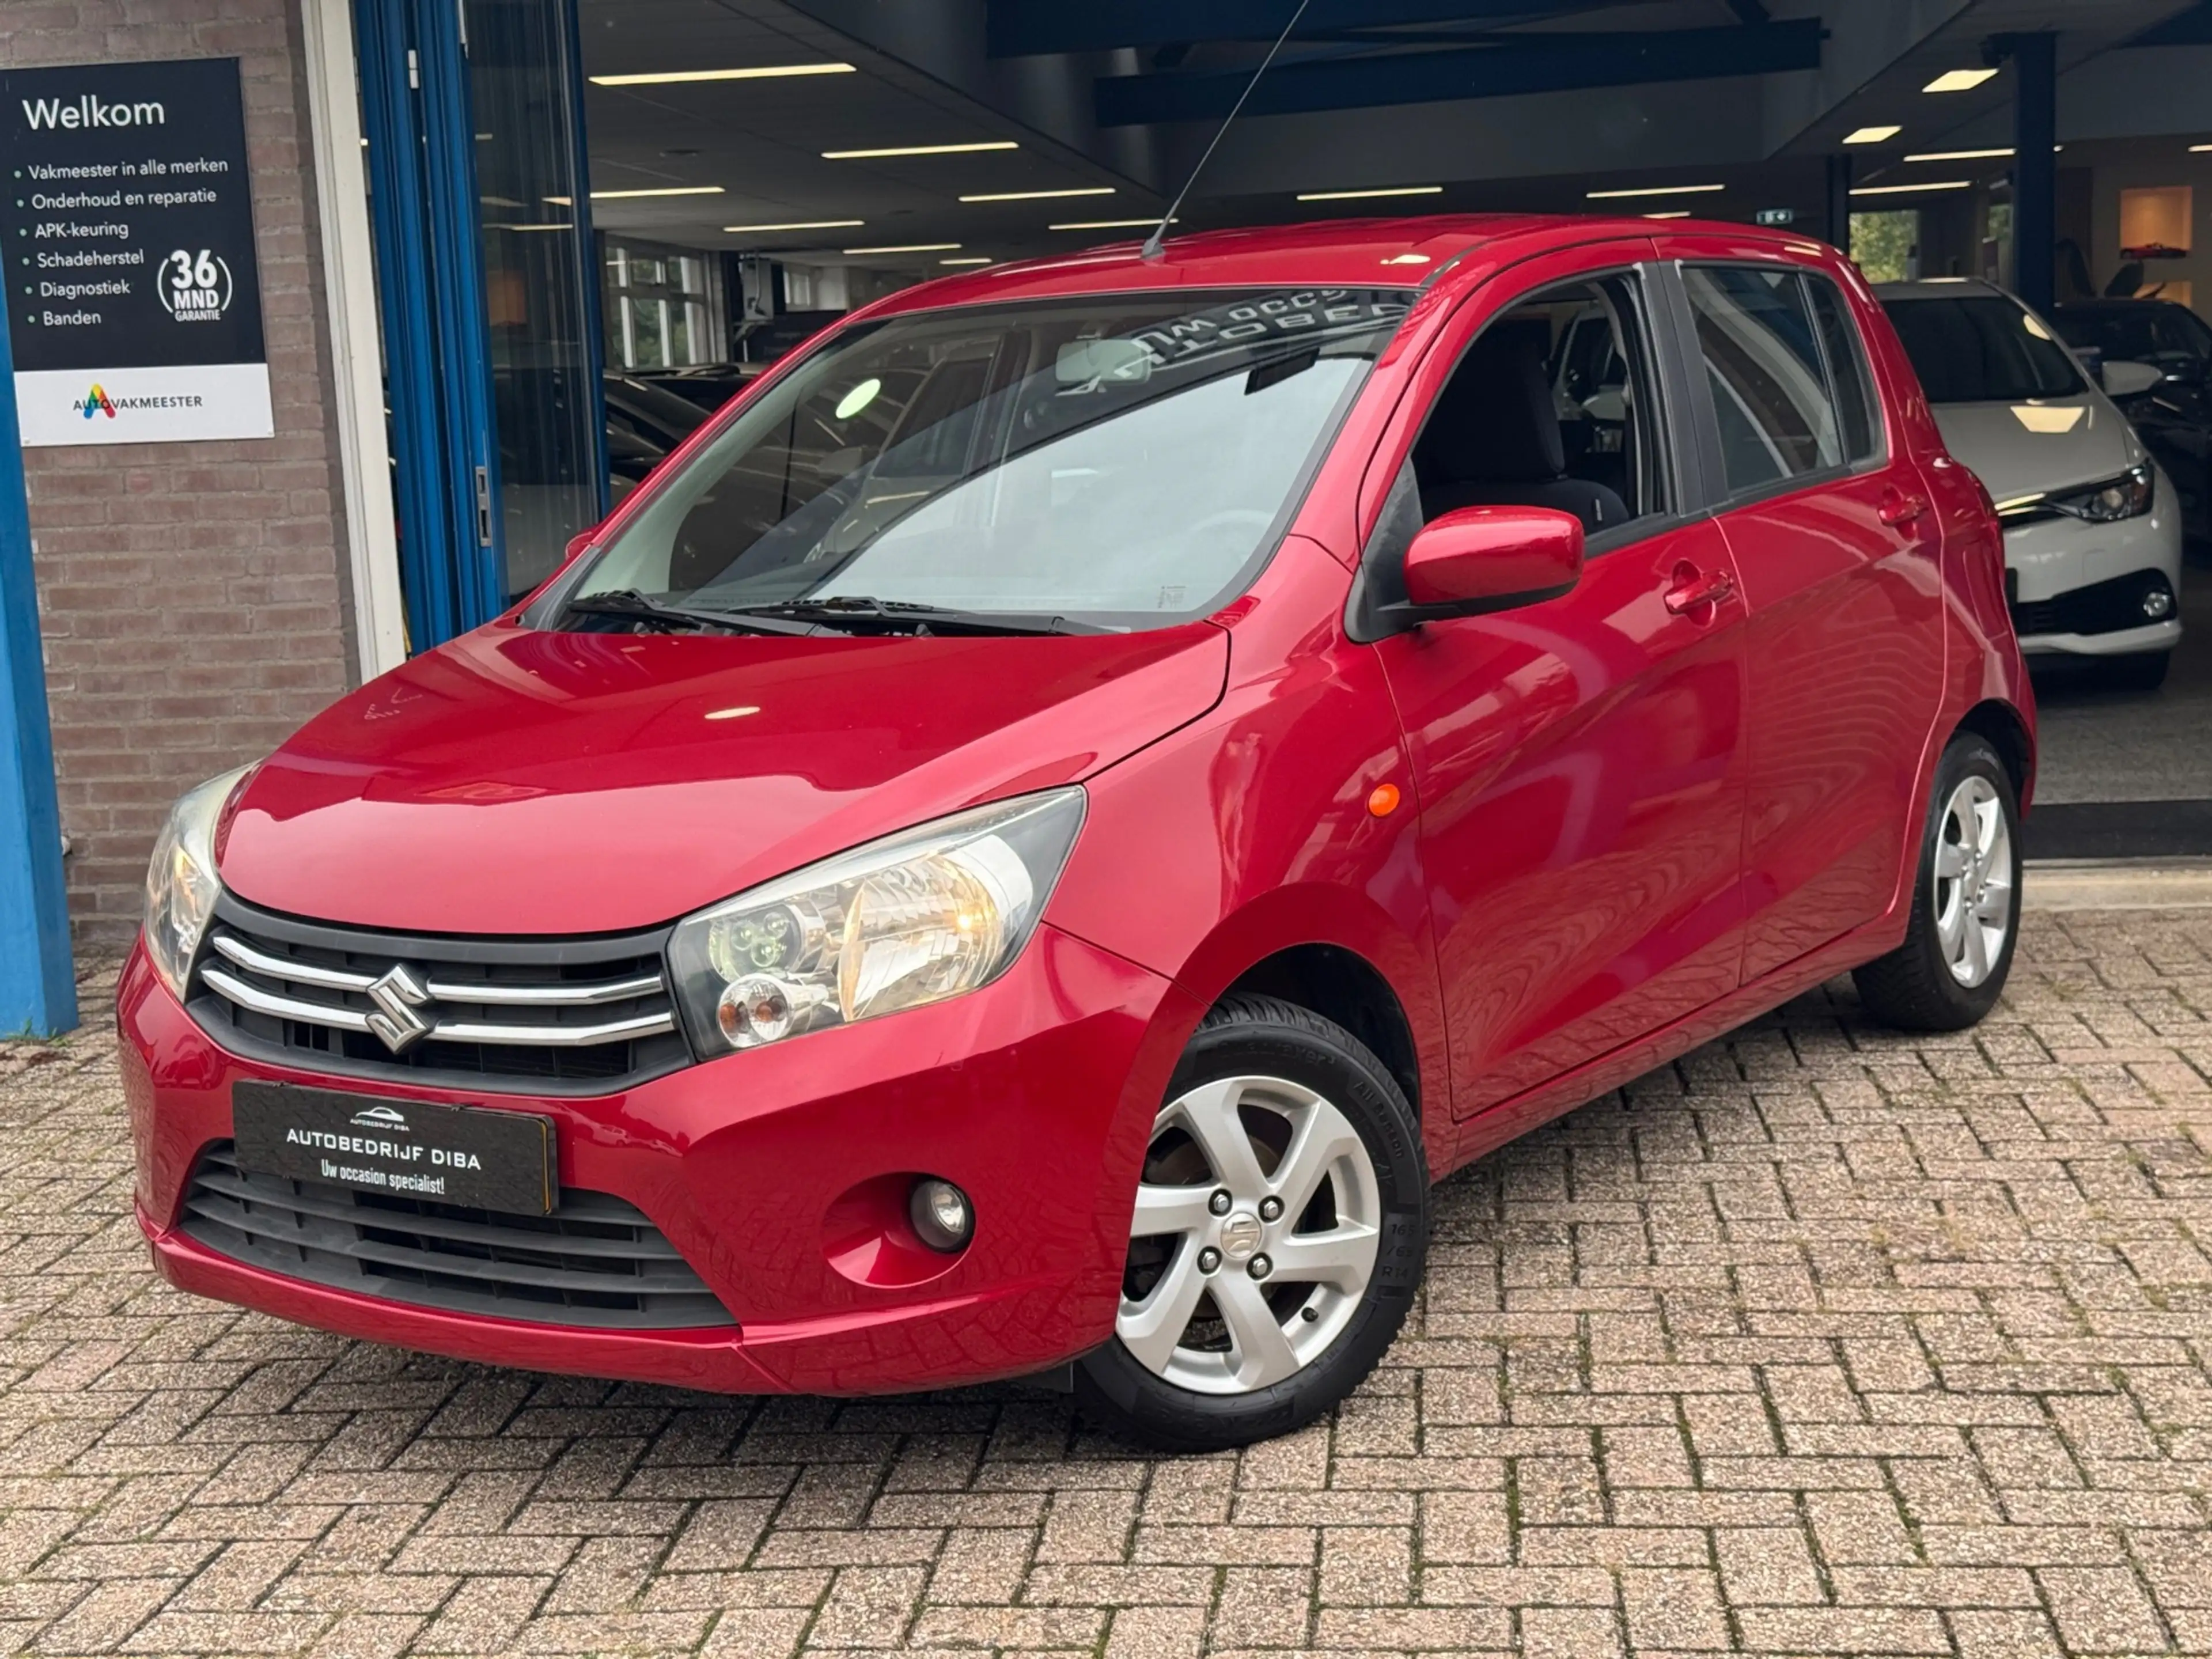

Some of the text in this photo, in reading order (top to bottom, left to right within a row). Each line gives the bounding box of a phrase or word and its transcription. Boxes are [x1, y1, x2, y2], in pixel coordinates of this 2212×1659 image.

[21, 94, 165, 130] Welkom
[28, 156, 229, 180] Vakmeester in alle merken
[32, 187, 217, 210] Onderhoud en reparatie
[35, 221, 129, 240] APK-keuring
[37, 248, 145, 268] Schadeherstel
[170, 249, 218, 289] 36
[40, 278, 131, 300] Diagnostiek
[173, 289, 219, 309] MND
[43, 309, 102, 327] Banden
[175, 309, 221, 322] GARANTIE
[73, 395, 203, 411] AUTOVAKMEESTER
[286, 1127, 482, 1171] AUTOBEDRIJF DIBA
[321, 1158, 445, 1195] Uw occasion specialist!
